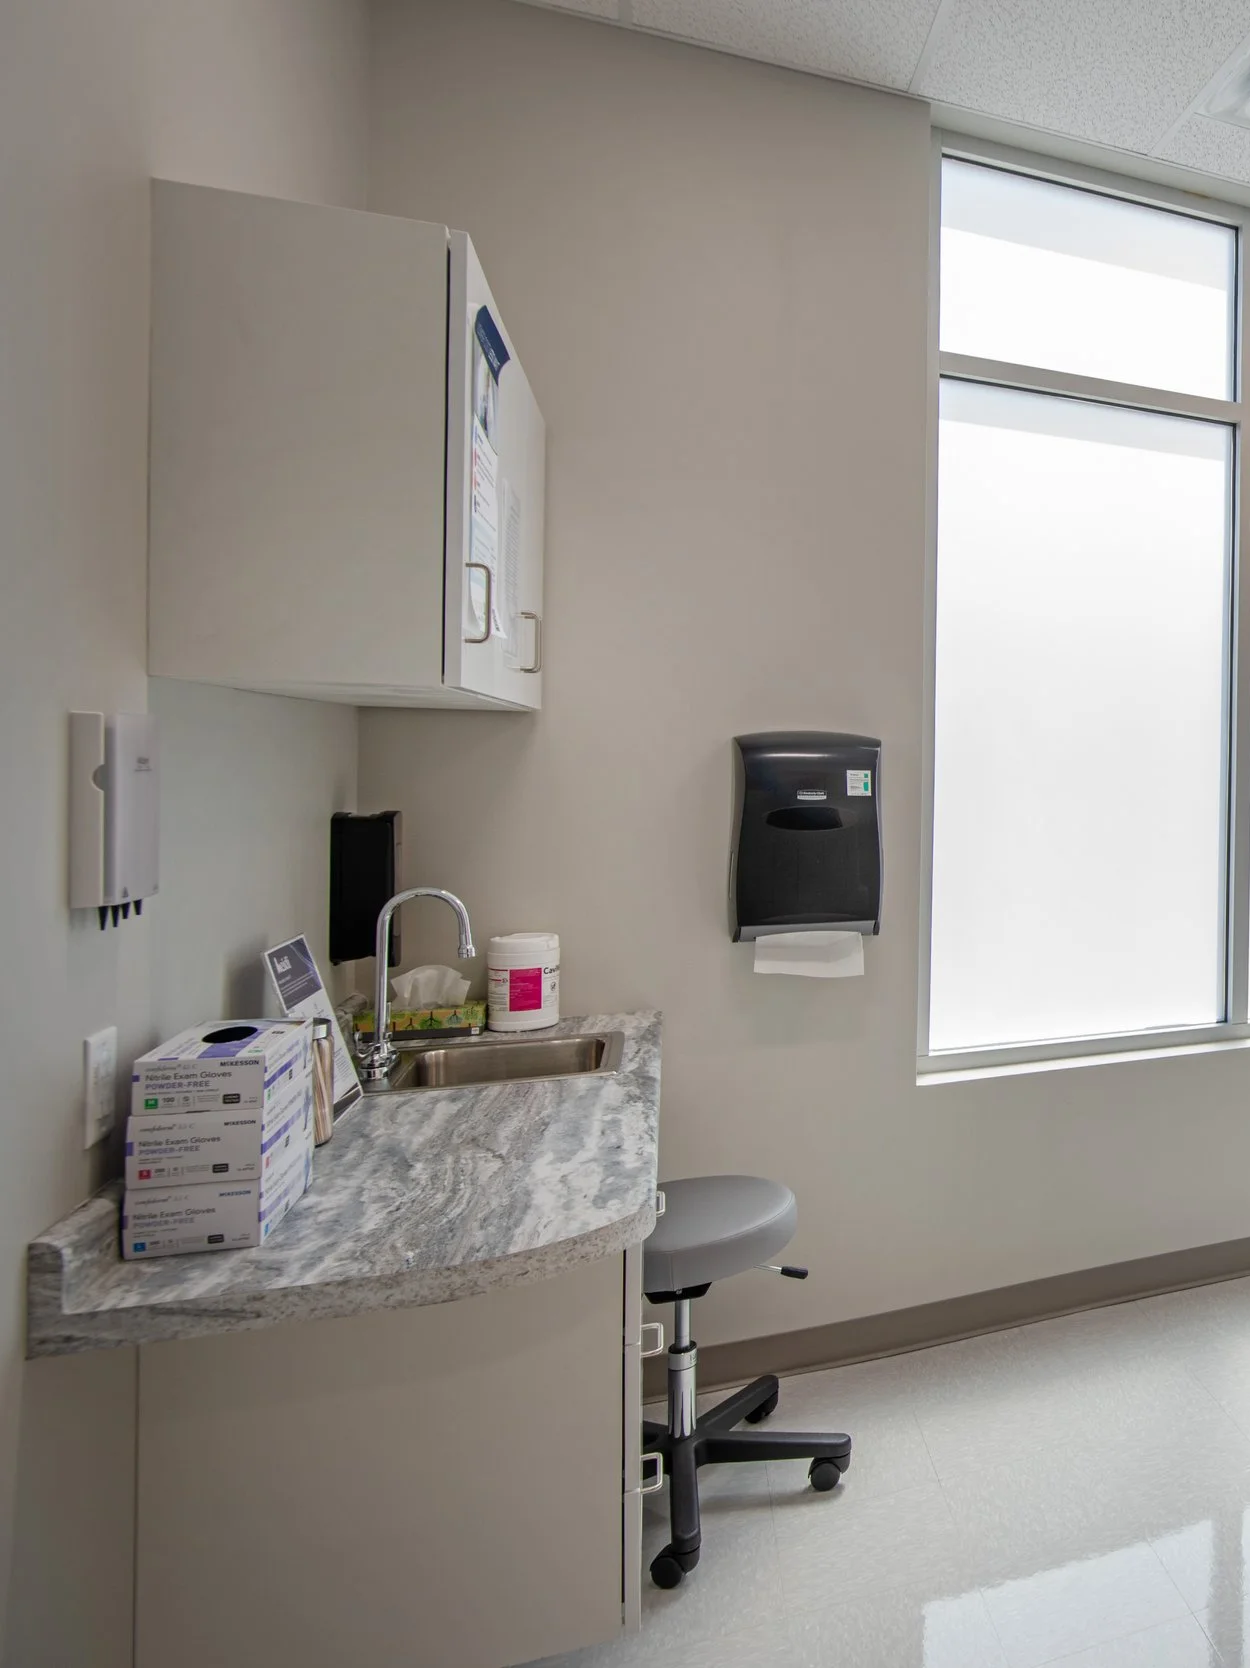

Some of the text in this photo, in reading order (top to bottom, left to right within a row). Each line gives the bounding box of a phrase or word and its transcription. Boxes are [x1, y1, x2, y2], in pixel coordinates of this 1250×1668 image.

[145, 1071, 232, 1082] Nitrile Exam Gloves
[145, 1080, 211, 1090] POWDER-FREE
[138, 1136, 221, 1147] Nitrile Exam Gloves
[138, 1145, 201, 1156] POWDER-FREE
[133, 1207, 216, 1220] Nitrile Exam Gloves
